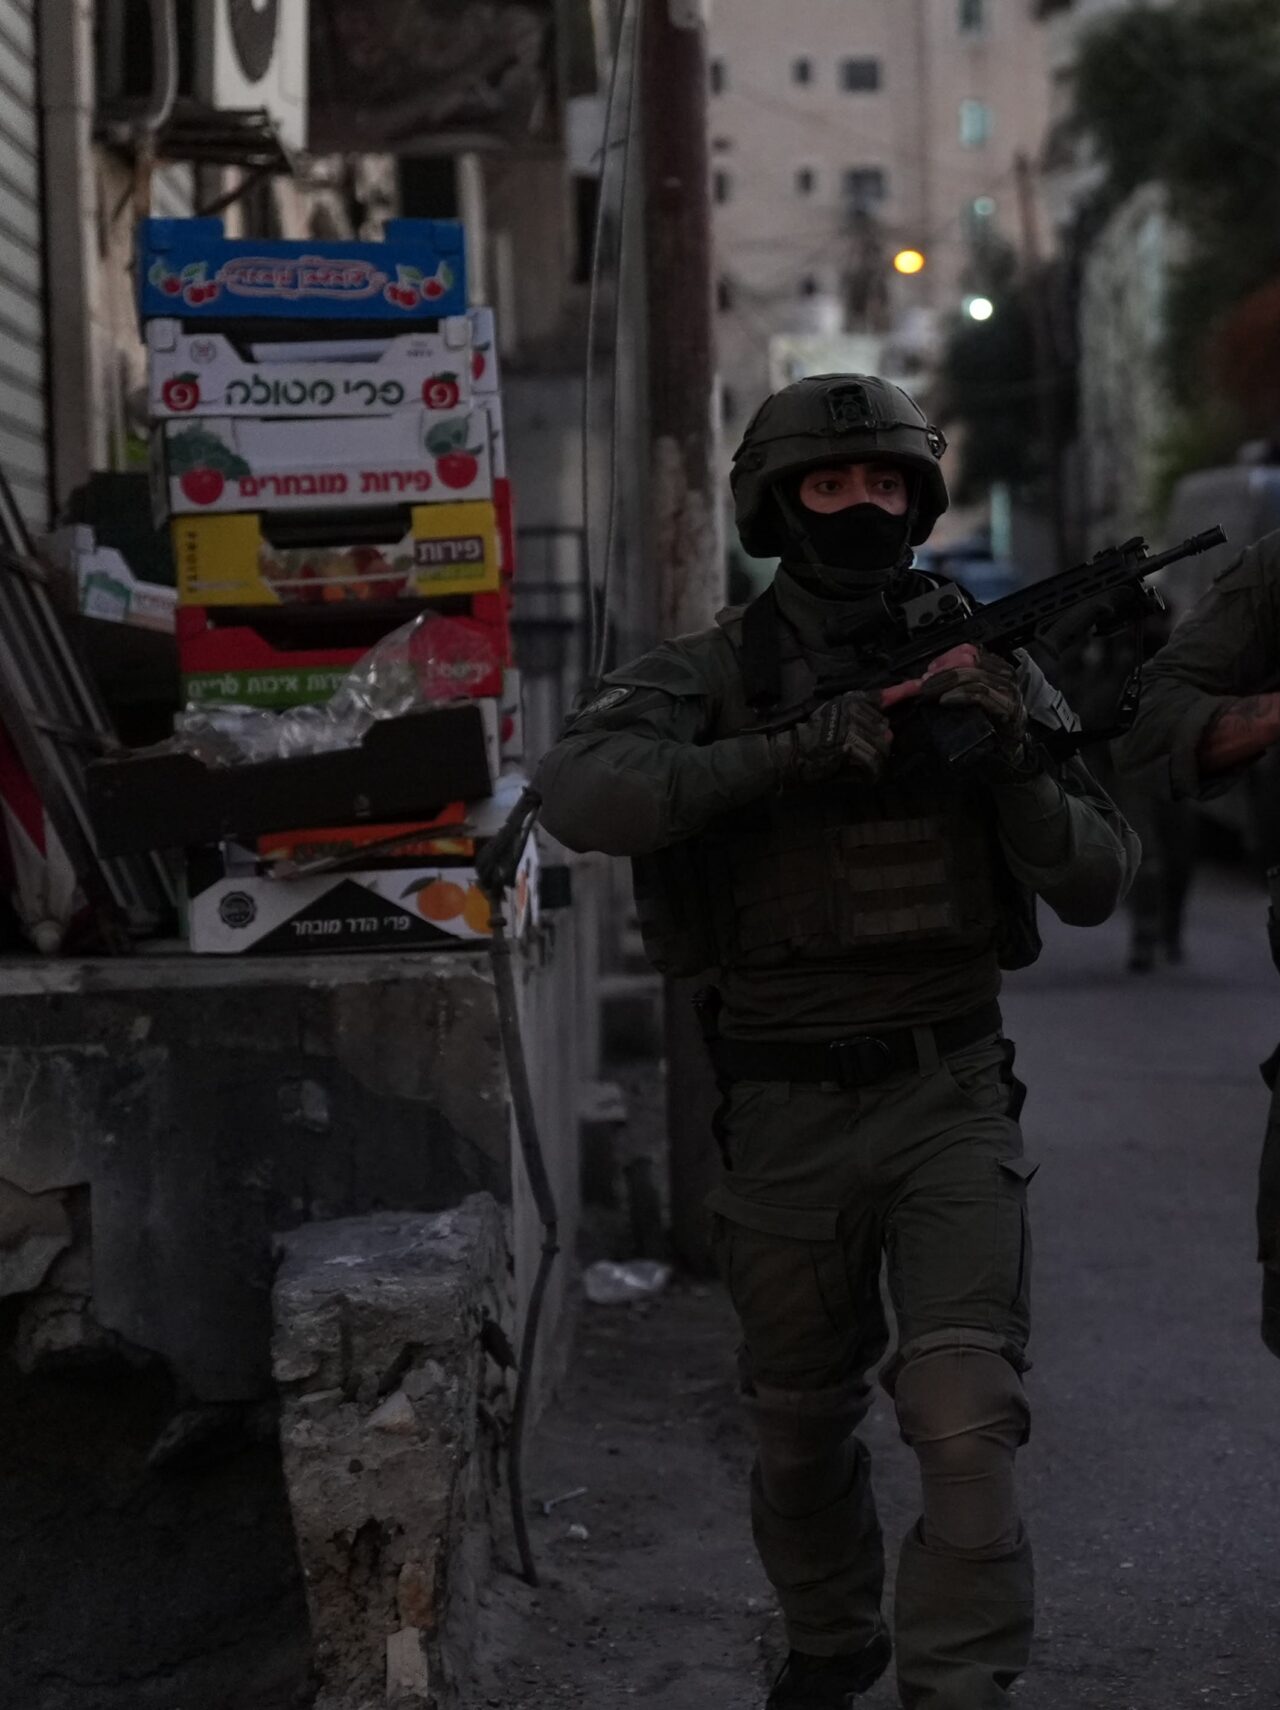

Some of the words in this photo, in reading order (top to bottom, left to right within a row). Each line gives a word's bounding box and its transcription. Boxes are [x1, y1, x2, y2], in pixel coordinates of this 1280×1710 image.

[226, 372, 335, 406] מטולה
[344, 380, 405, 405] פרי
[238, 472, 348, 497] מובחרים
[361, 469, 433, 493] פירות
[419, 539, 481, 562] פירות
[290, 918, 342, 936] מובחר
[345, 916, 379, 933] הדר
[383, 914, 412, 931] פרי
